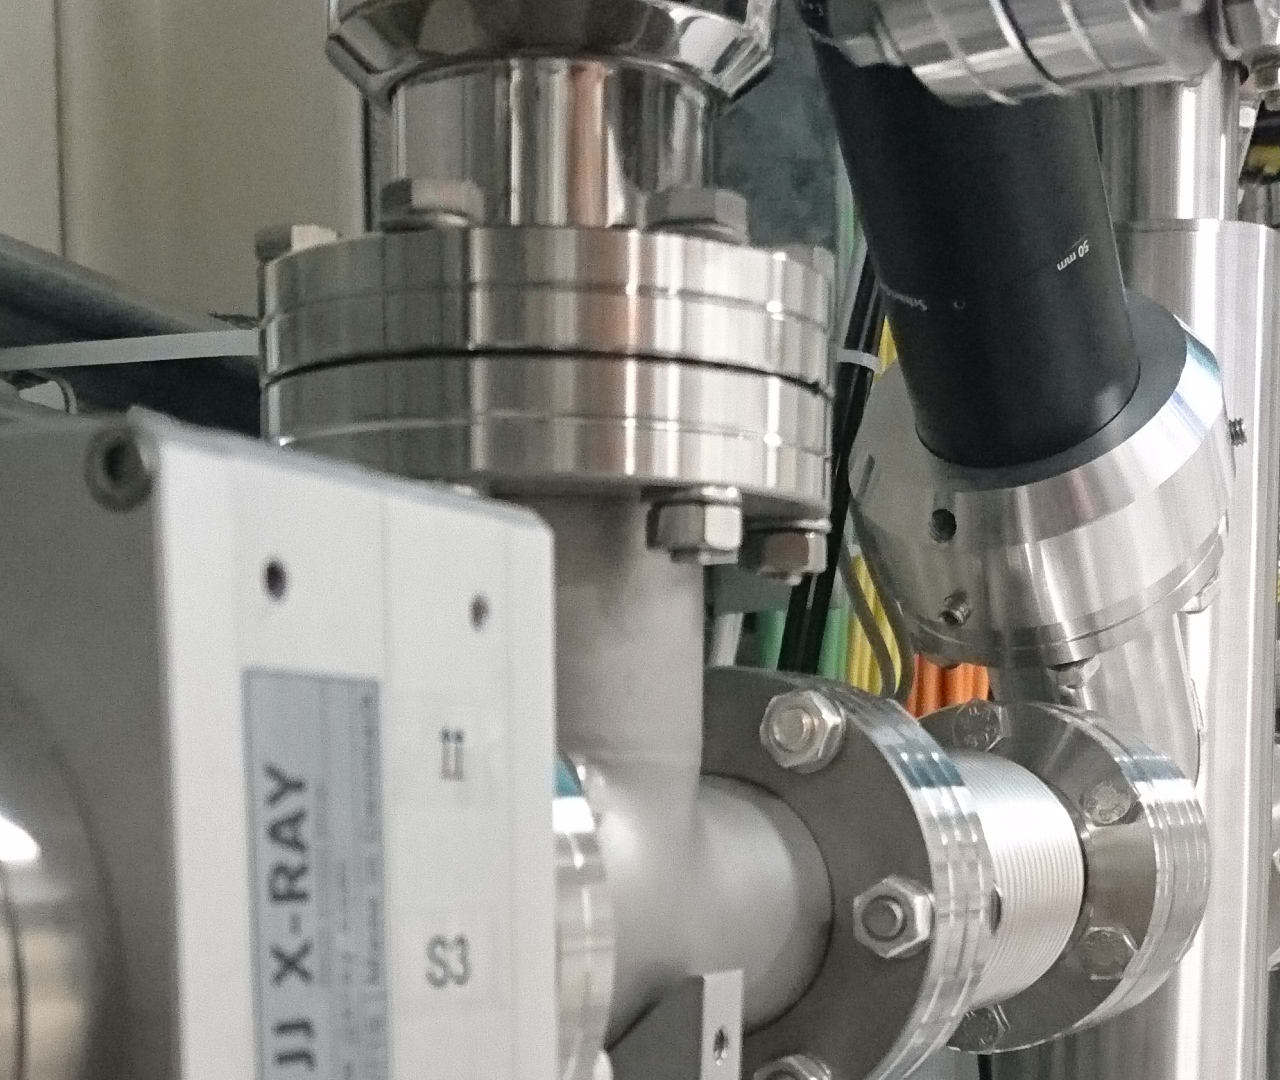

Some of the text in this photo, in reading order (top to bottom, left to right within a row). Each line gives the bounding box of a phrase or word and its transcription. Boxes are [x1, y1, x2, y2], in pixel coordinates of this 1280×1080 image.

[1056, 239, 1089, 271] 50 mm
[263, 763, 316, 1072] JJ X-RAY
[425, 933, 471, 988] S3
